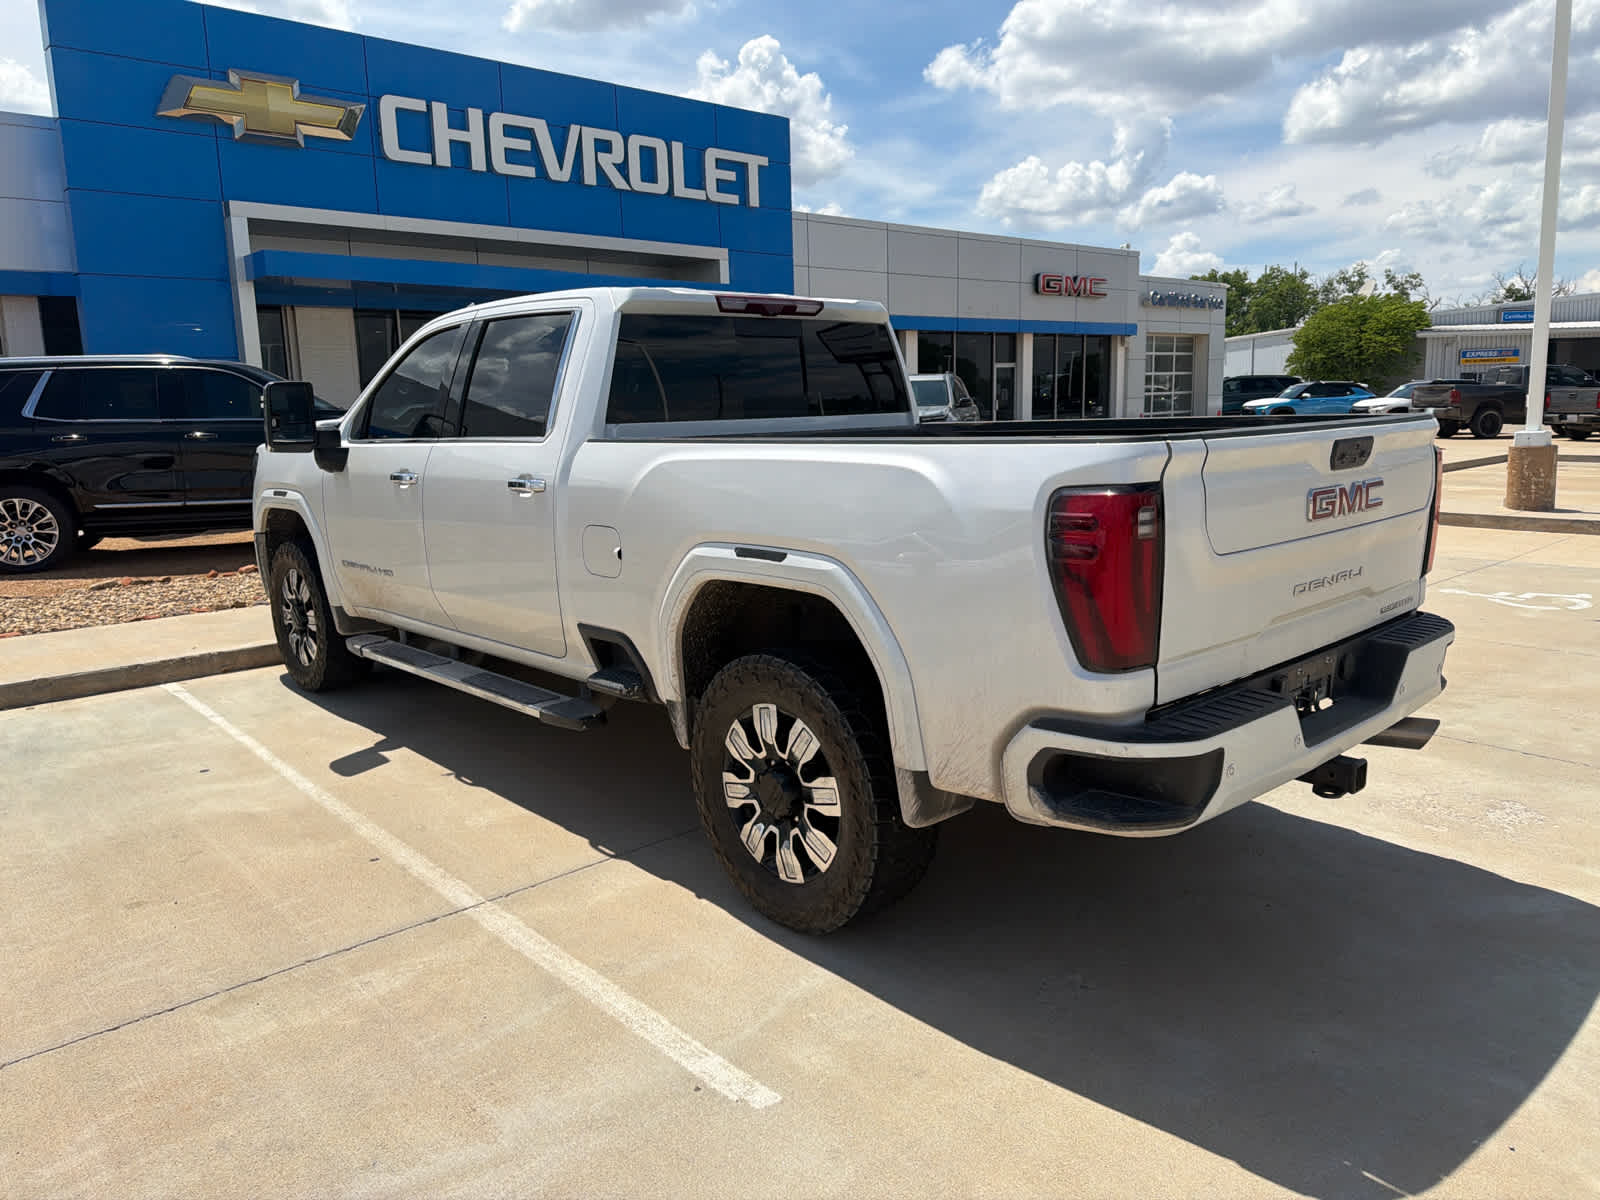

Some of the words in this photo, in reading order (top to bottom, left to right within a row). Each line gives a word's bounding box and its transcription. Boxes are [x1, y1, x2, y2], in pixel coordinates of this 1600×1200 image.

[379, 94, 769, 208] CHEVROLET
[1036, 273, 1108, 297] GMC
[1307, 477, 1384, 522] GMC
[1292, 566, 1363, 598] DENALI
